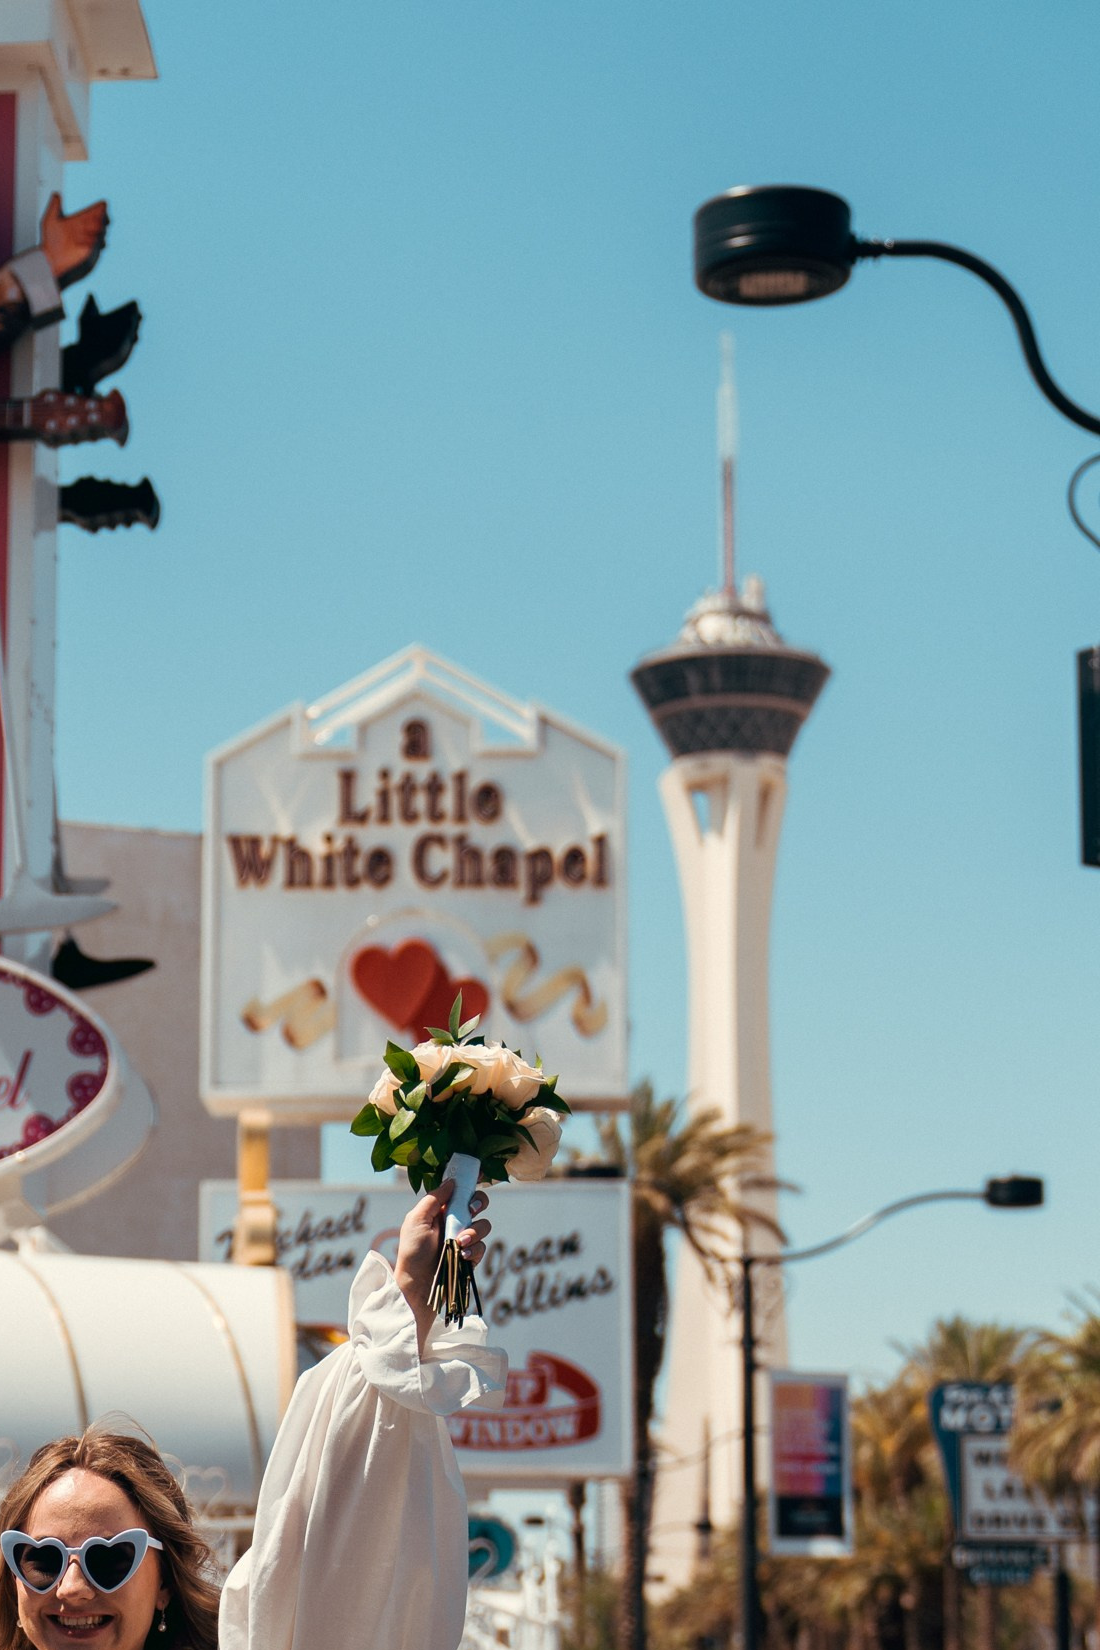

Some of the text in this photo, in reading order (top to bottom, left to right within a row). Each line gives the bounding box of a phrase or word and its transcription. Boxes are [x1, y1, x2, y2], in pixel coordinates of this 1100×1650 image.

[401, 718, 432, 762] a
[336, 768, 507, 827] Little
[226, 832, 611, 906] White Chapel
[474, 1263, 614, 1327] ollins
[483, 1229, 582, 1300] Joan
